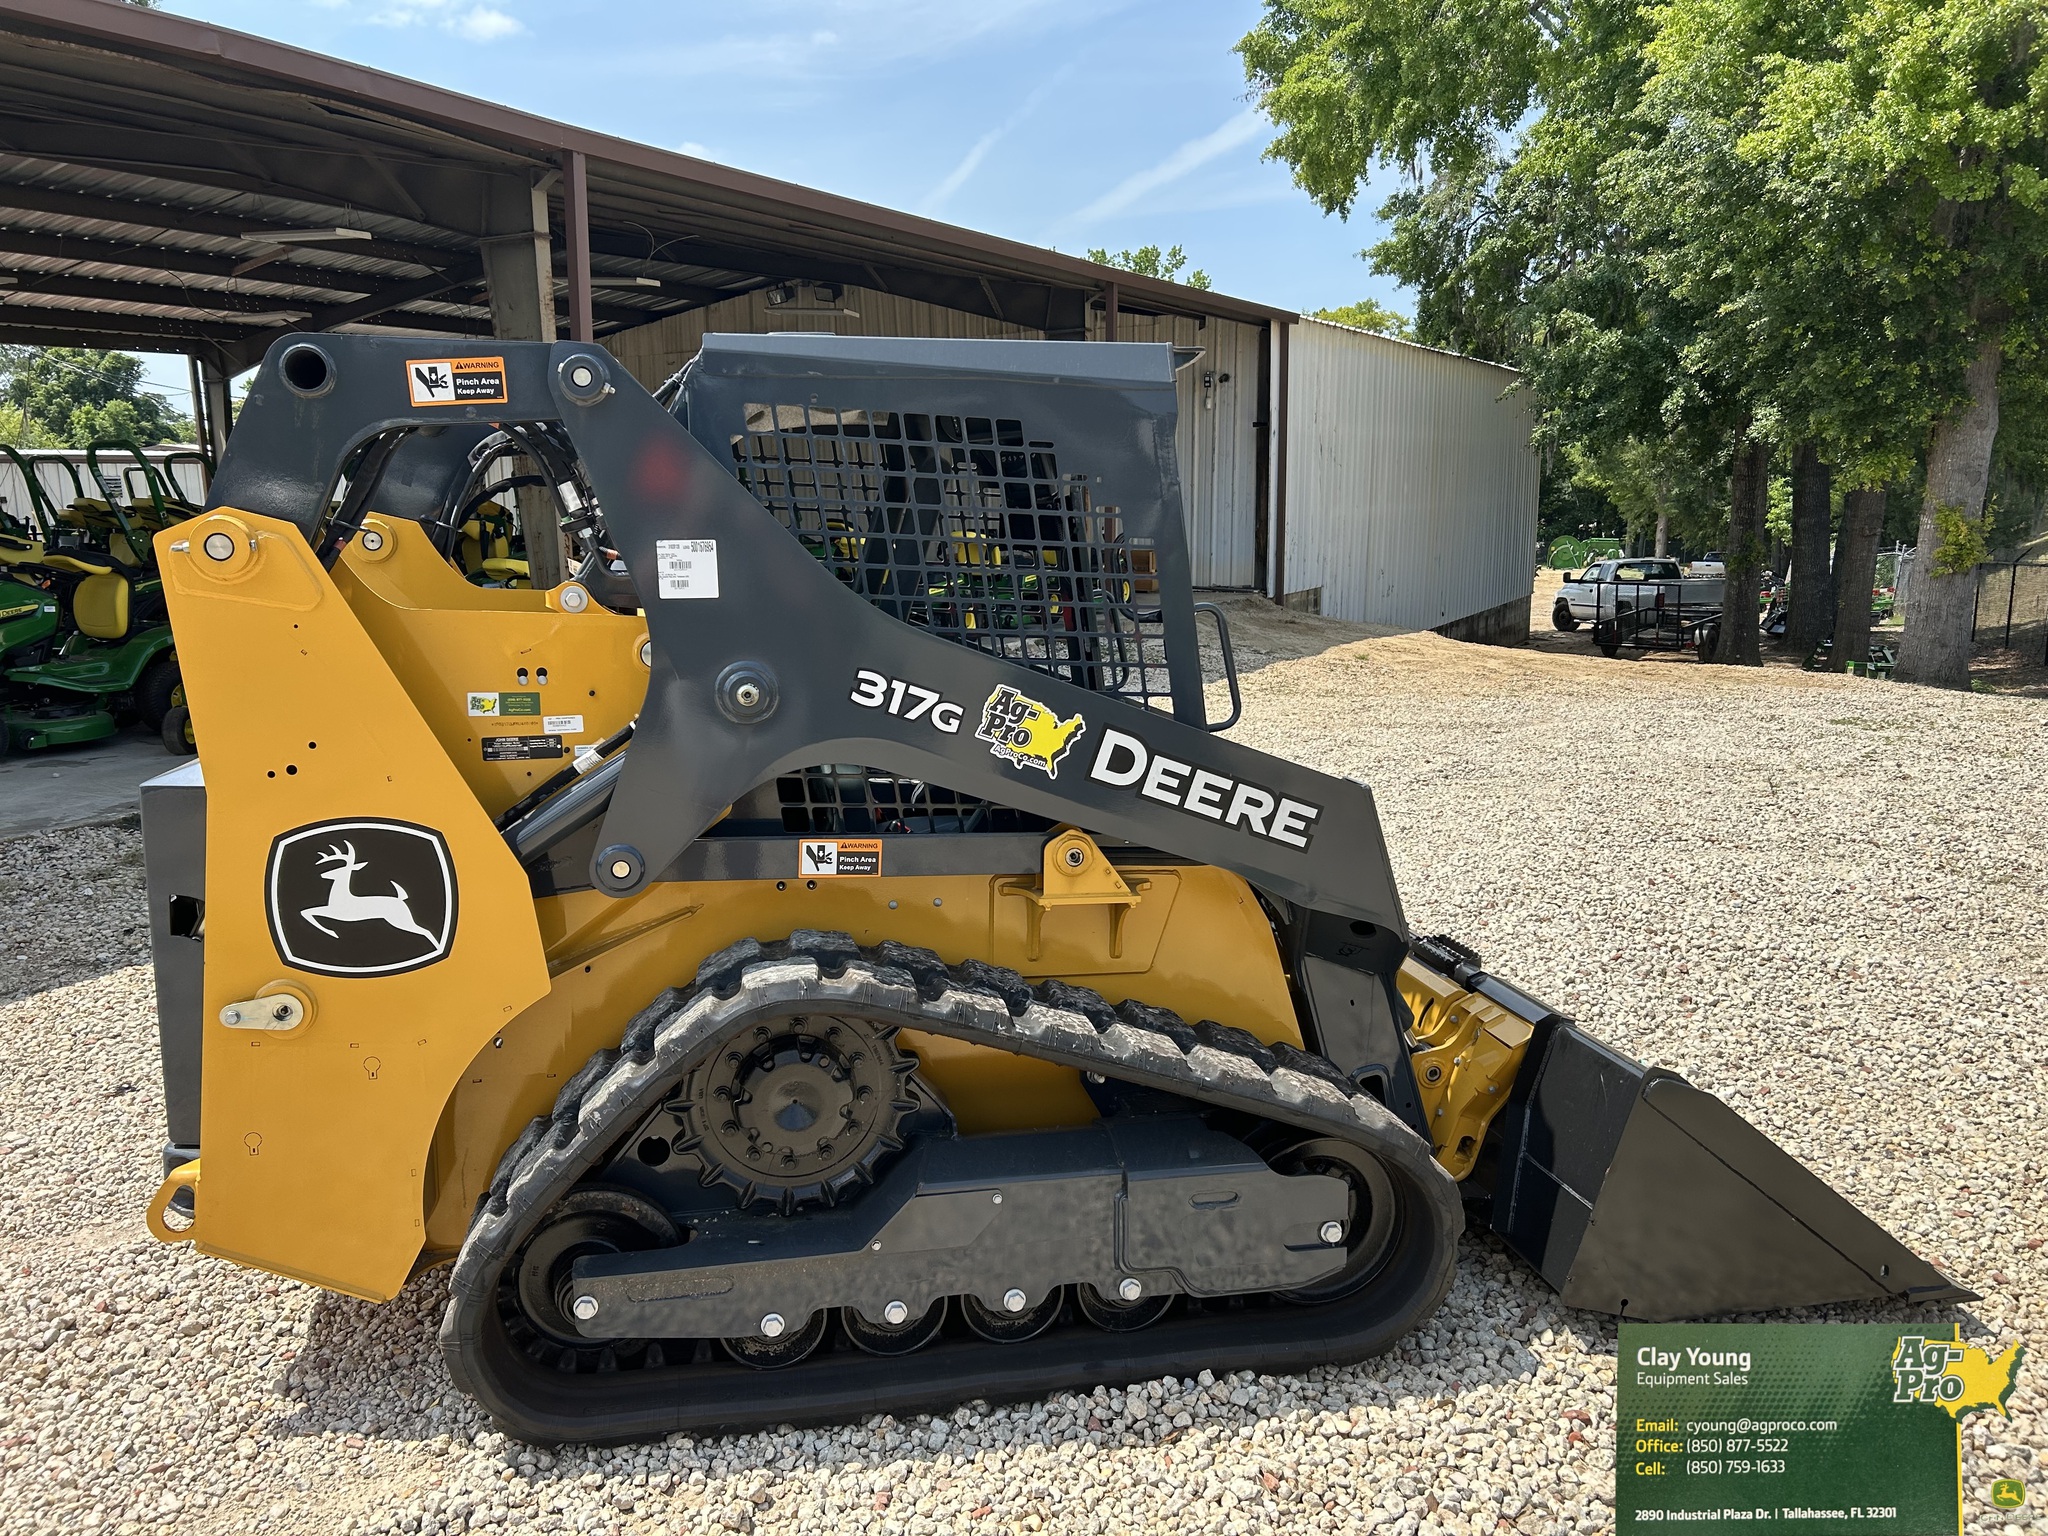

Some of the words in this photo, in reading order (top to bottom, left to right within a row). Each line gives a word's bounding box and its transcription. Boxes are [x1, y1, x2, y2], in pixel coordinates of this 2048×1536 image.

[456, 378, 479, 386] Pinch
[2, 608, 22, 616] DEERE
[851, 670, 964, 733] 317G
[988, 689, 1040, 722] Ag-
[980, 711, 1032, 748] Pro
[994, 744, 1046, 767] AgProCo.com
[1090, 728, 1319, 848] DEERE
